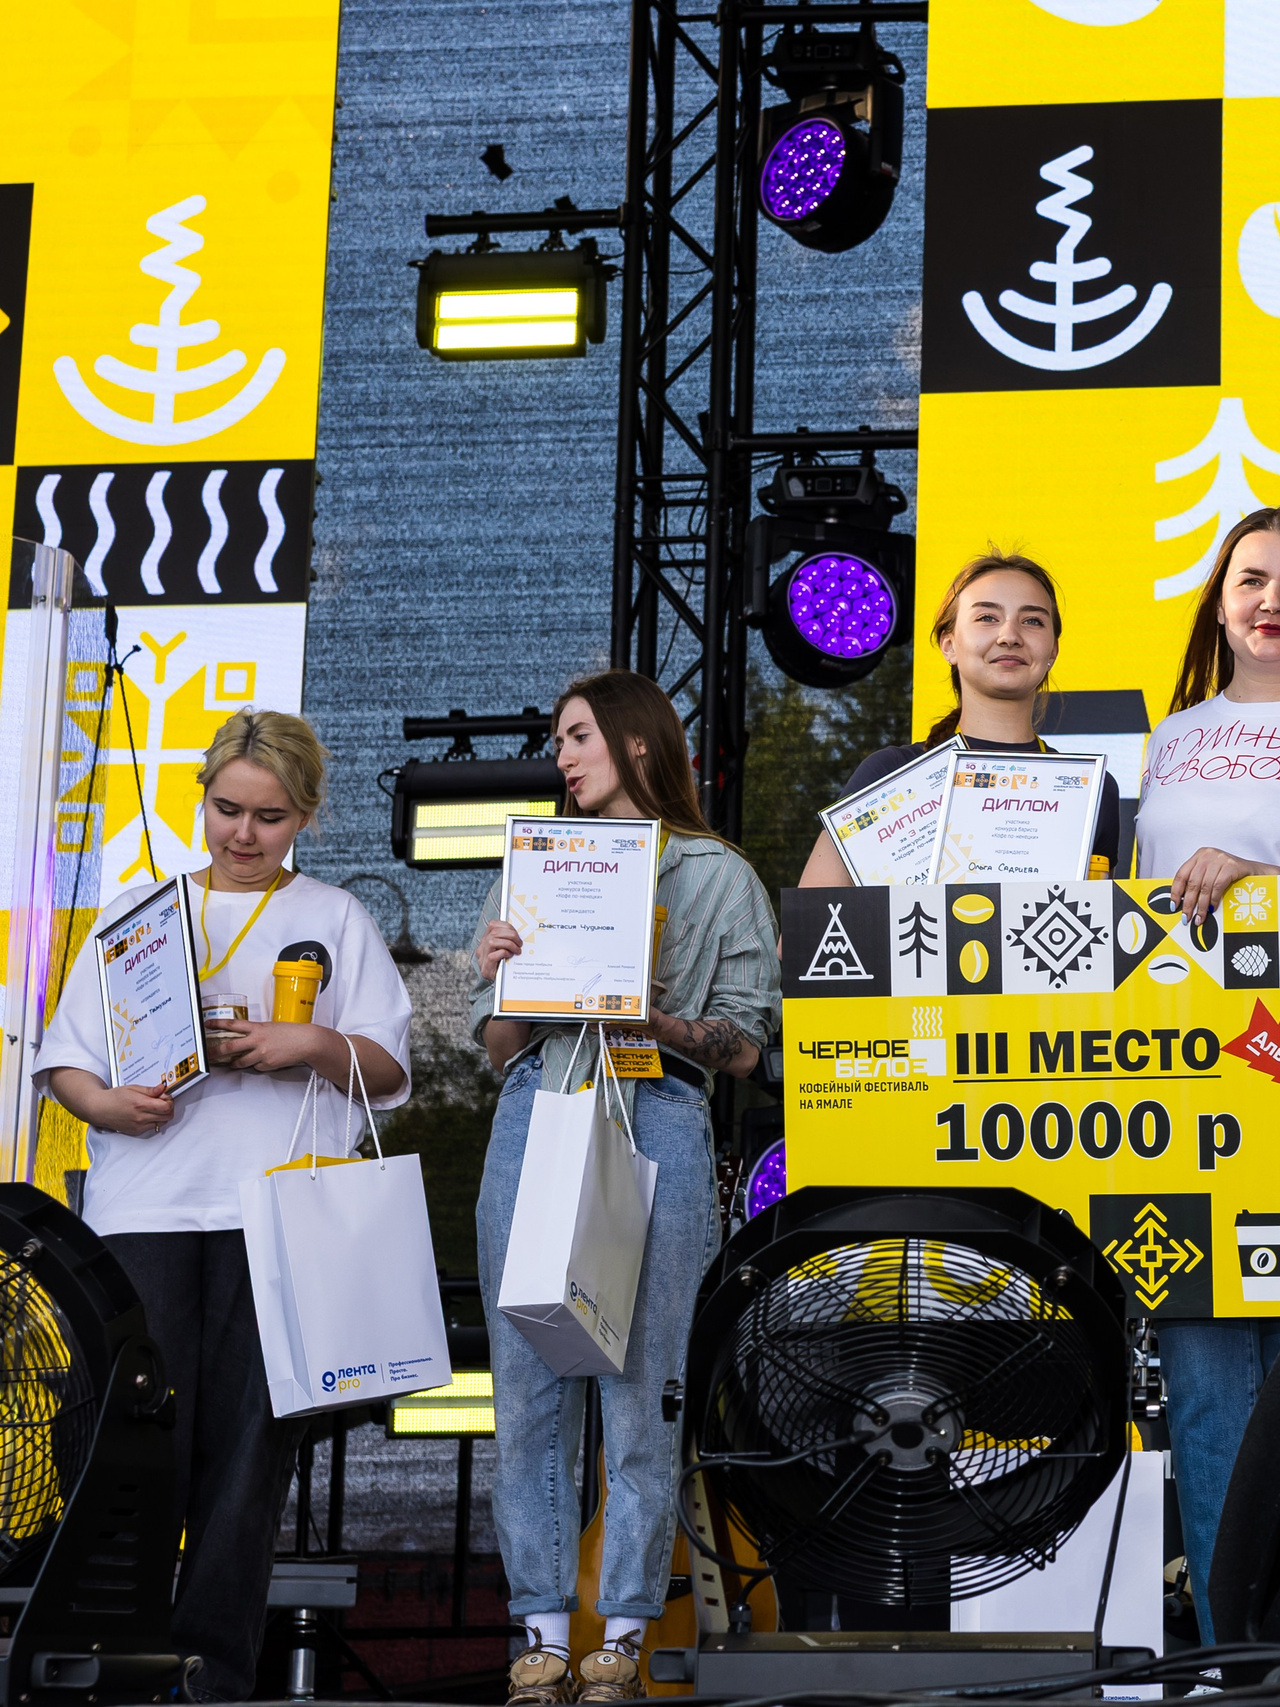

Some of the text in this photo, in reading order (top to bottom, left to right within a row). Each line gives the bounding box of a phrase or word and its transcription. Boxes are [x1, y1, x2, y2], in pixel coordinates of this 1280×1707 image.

[981, 797, 1059, 813] ДИПЛОМ
[543, 860, 619, 873] ДИПЛОМ
[124, 933, 167, 975] ДИПЛОМ
[799, 1039, 909, 1059] ЧЕРНОЕ
[1029, 1027, 1221, 1075] МЕСТО
[799, 1080, 929, 1094] КОФЕЙНЫЙ ФЕСТИВАЛЬ
[799, 1098, 853, 1110] НА ЯМАЛЕ
[935, 1100, 1242, 1172] 10000 р
[337, 1363, 377, 1379] лента
[338, 1378, 361, 1393] pro
